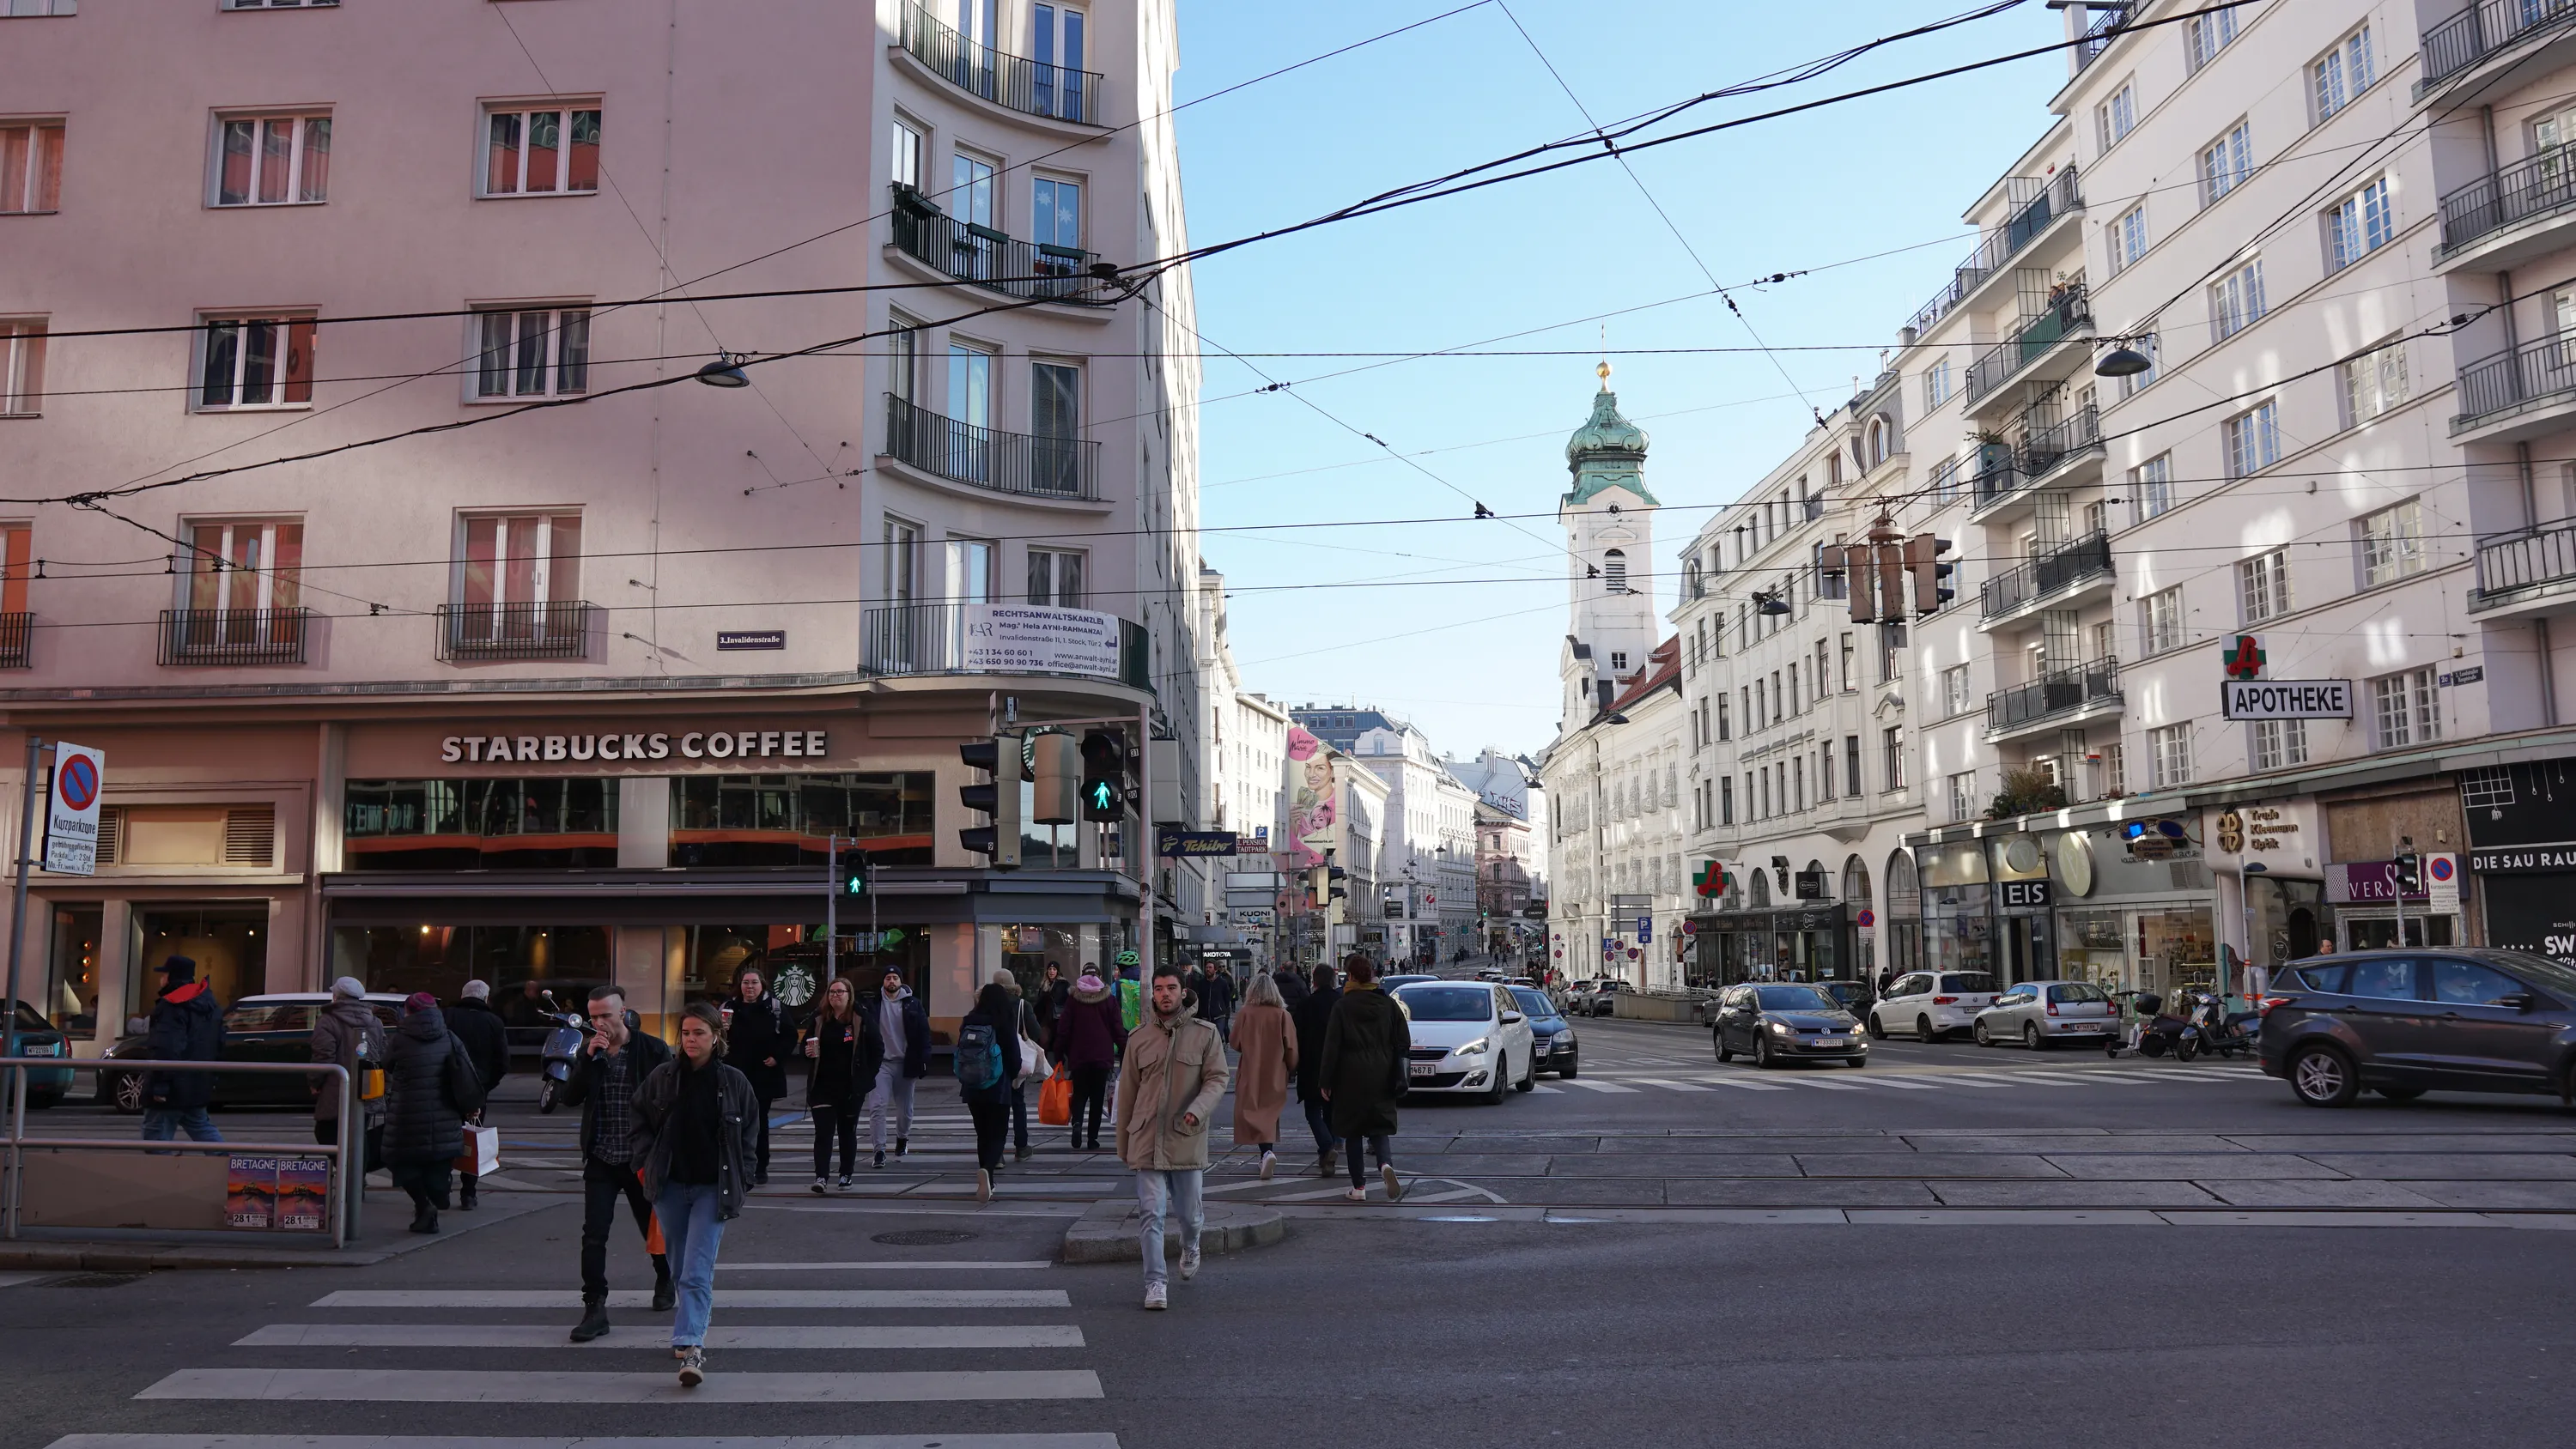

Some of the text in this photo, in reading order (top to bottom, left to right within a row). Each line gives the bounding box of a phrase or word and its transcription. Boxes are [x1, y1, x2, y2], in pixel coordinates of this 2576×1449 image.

[992, 609, 1104, 626] RECHTSANWALTSKANZLEI
[1023, 622, 1040, 631] Hela
[1042, 624, 1103, 636] AYNI-RAHMANZAI
[999, 634, 1054, 643] Invalidenstraße
[1054, 652, 1117, 665] www.anwalt-ayni.at
[2234, 686, 2344, 713] APOTHEKE
[440, 731, 826, 762] STARBUCKS COFFEE
[1289, 740, 1308, 753] Marie
[1297, 735, 1315, 745] Immo
[1127, 791, 1138, 799] 30
[2249, 809, 2280, 822] Trude
[53, 814, 96, 835] Kurzparkzone
[2250, 823, 2299, 835] Kleemann
[1182, 839, 1234, 852] Tchibo
[2251, 837, 2280, 851] Optik
[52, 850, 78, 860] Parkdar:
[82, 853, 93, 863] Std.
[2473, 855, 2498, 870] DIE
[2502, 853, 2534, 869] SAU
[2008, 883, 2044, 904] EIS
[230, 1159, 276, 1170] BRETAGNE
[280, 1160, 326, 1171] BRETAGNE
